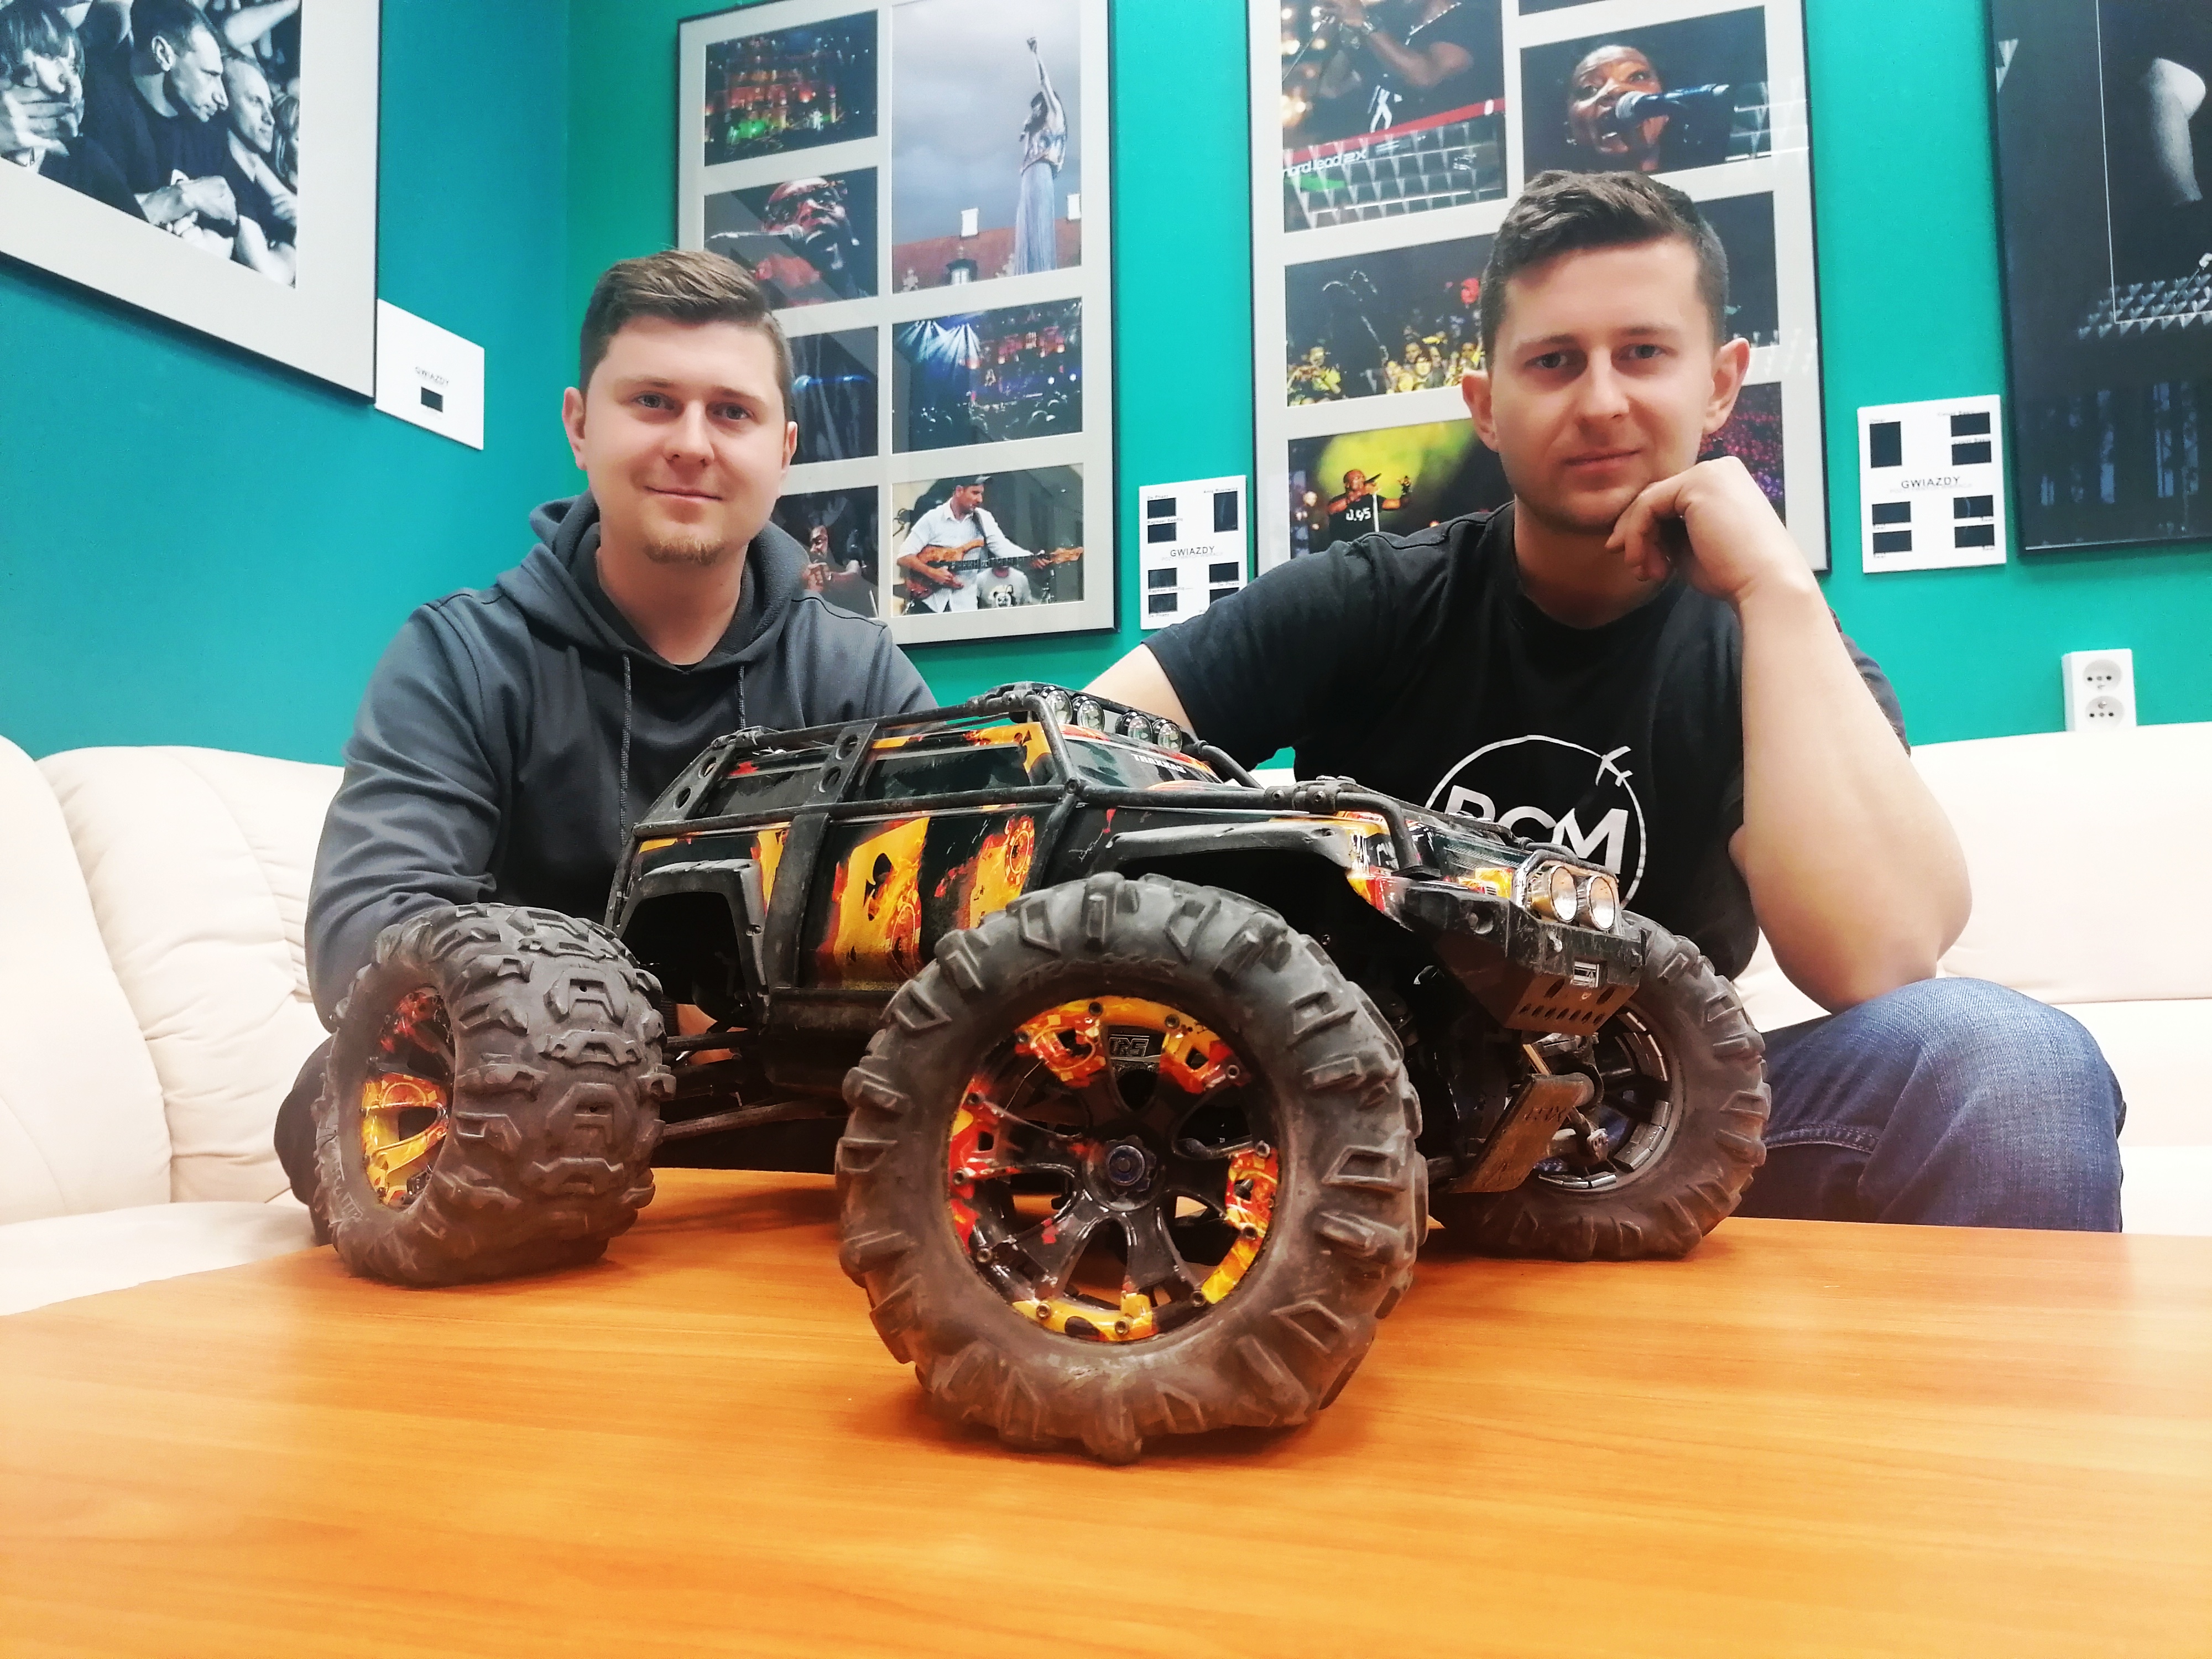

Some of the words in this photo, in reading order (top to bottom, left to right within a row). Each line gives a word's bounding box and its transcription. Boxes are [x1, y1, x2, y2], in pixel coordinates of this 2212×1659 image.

[1901, 477, 1960, 489] GWIAZDY
[1170, 546, 1215, 557] GWIAZDY
[1131, 753, 1187, 774] TRAXXAS
